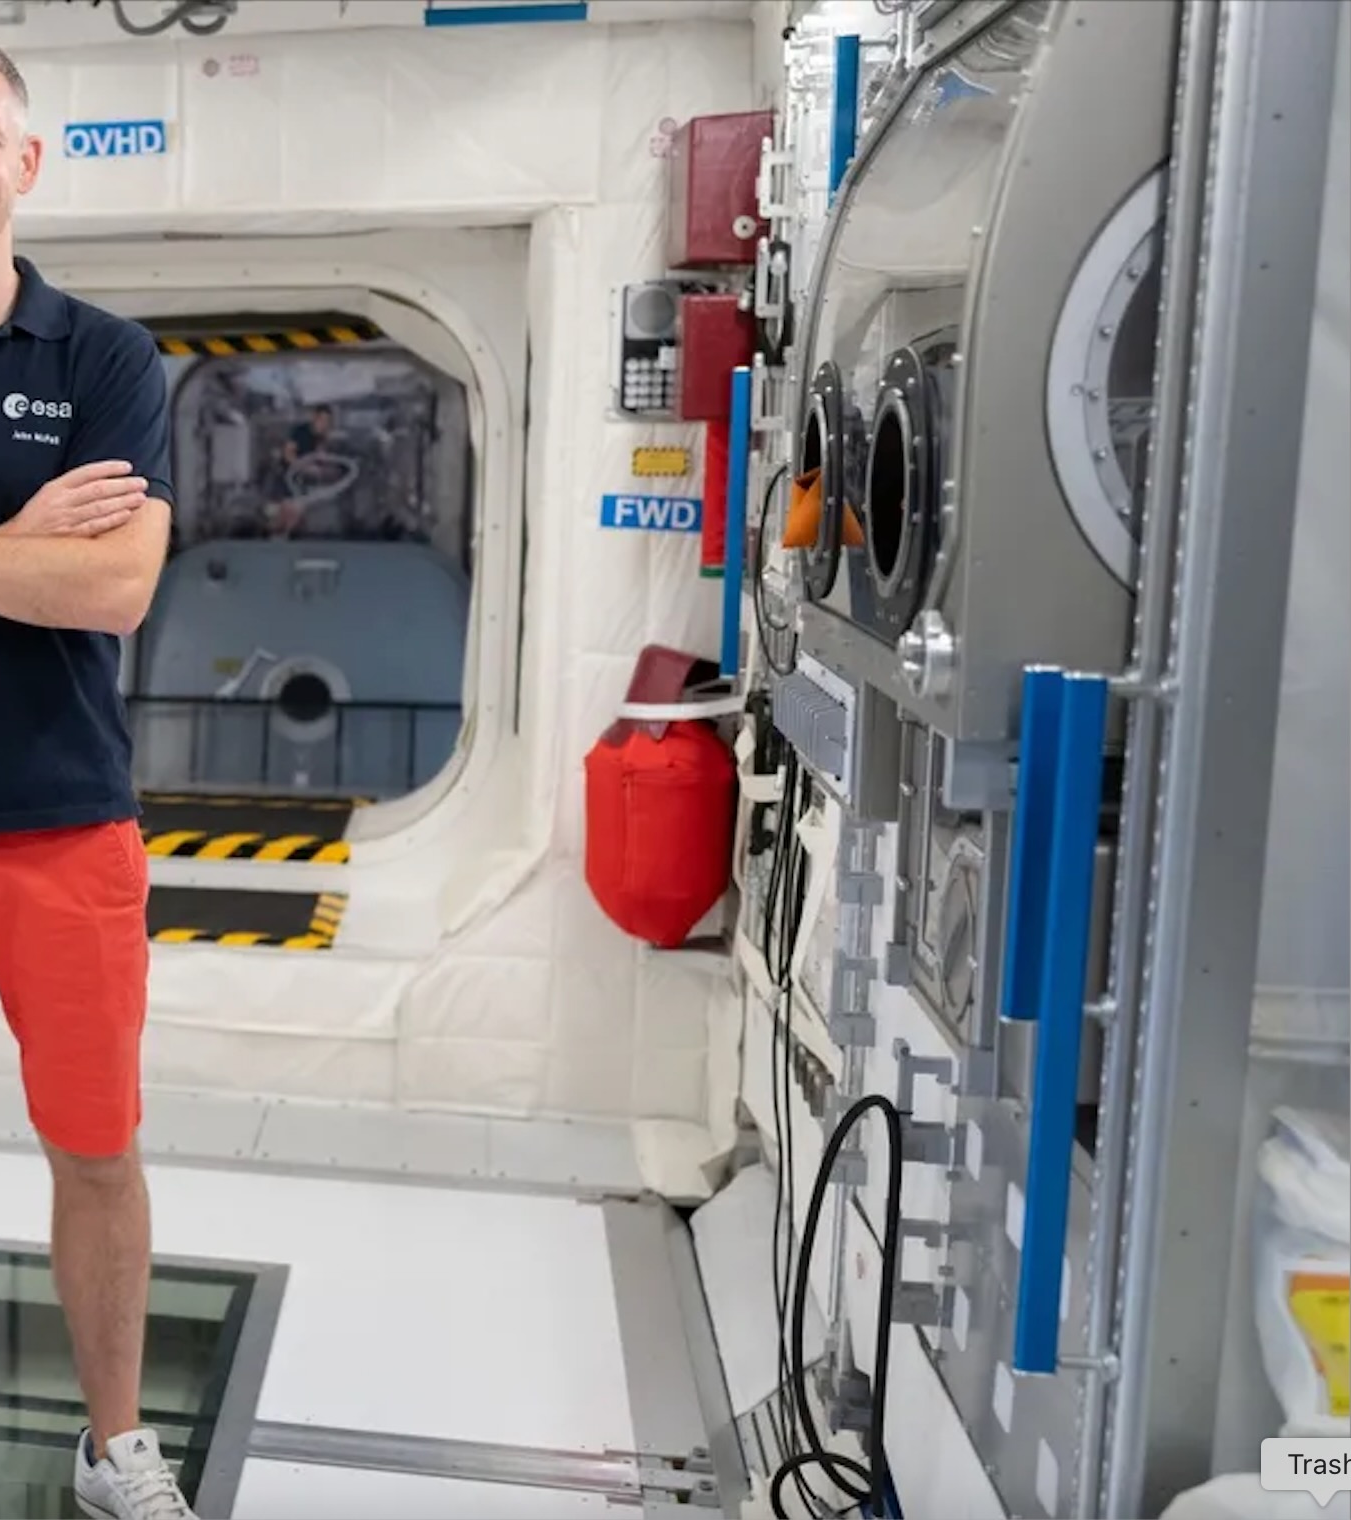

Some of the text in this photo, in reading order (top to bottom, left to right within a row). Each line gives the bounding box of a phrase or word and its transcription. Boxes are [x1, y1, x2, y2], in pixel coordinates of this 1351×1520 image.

[66, 126, 163, 157] OVHD
[31, 398, 73, 419] esa
[614, 496, 697, 529] FWD
